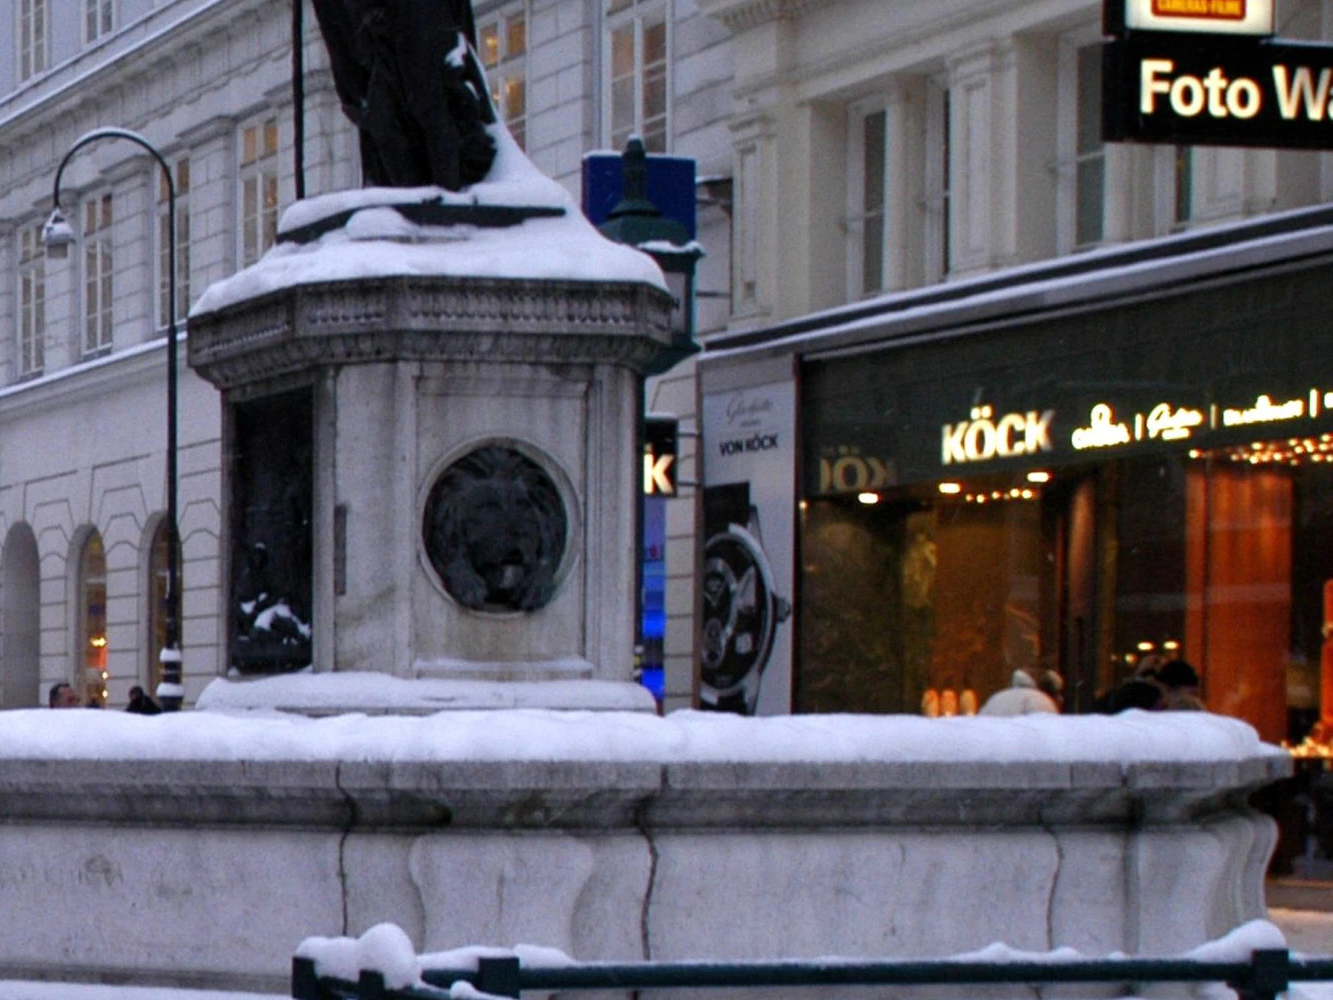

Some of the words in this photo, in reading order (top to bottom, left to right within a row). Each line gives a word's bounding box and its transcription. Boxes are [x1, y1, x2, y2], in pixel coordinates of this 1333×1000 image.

[1140, 58, 1261, 118] Foto
[1272, 64, 1333, 121] W
[941, 404, 1055, 466] KÖCK
